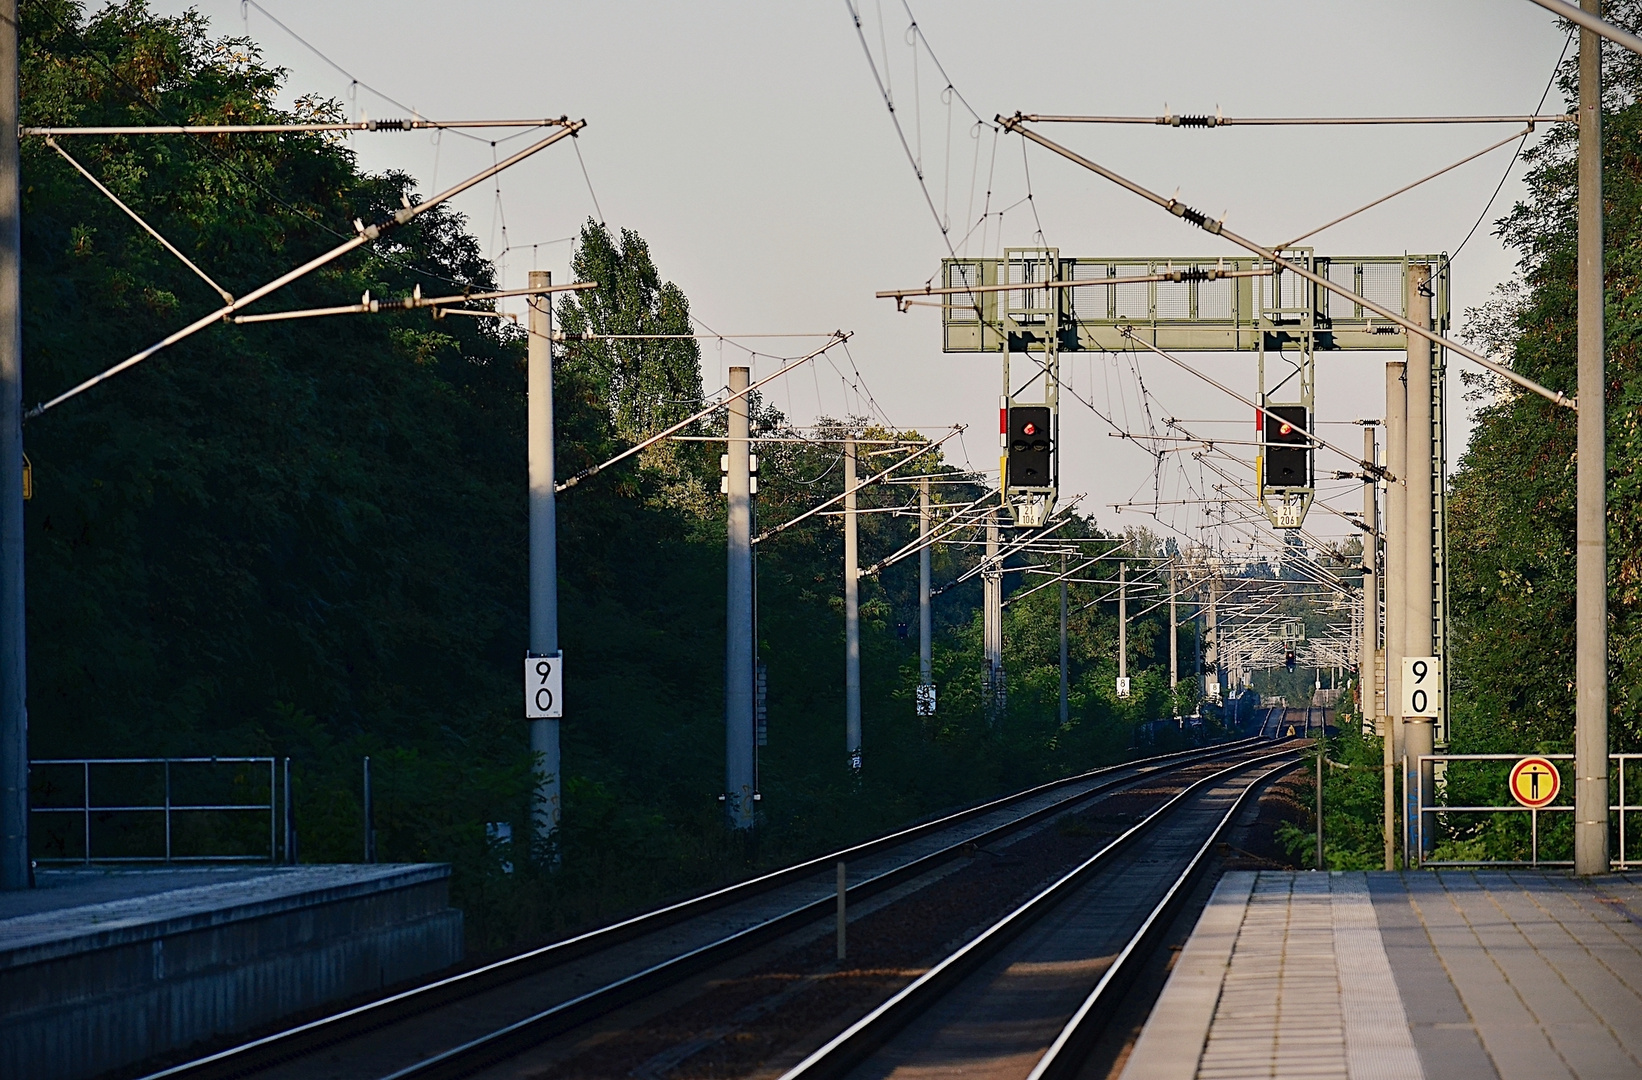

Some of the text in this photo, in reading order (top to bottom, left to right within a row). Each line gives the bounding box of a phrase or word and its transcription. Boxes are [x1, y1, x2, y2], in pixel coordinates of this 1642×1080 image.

[1024, 505, 1033, 515] 21
[1283, 506, 1292, 516] 21
[1022, 515, 1035, 525] 106
[1280, 515, 1295, 525] 206
[535, 661, 552, 685] 9
[1412, 660, 1428, 685] 9
[535, 687, 553, 712] 0
[1412, 689, 1428, 713] 0
